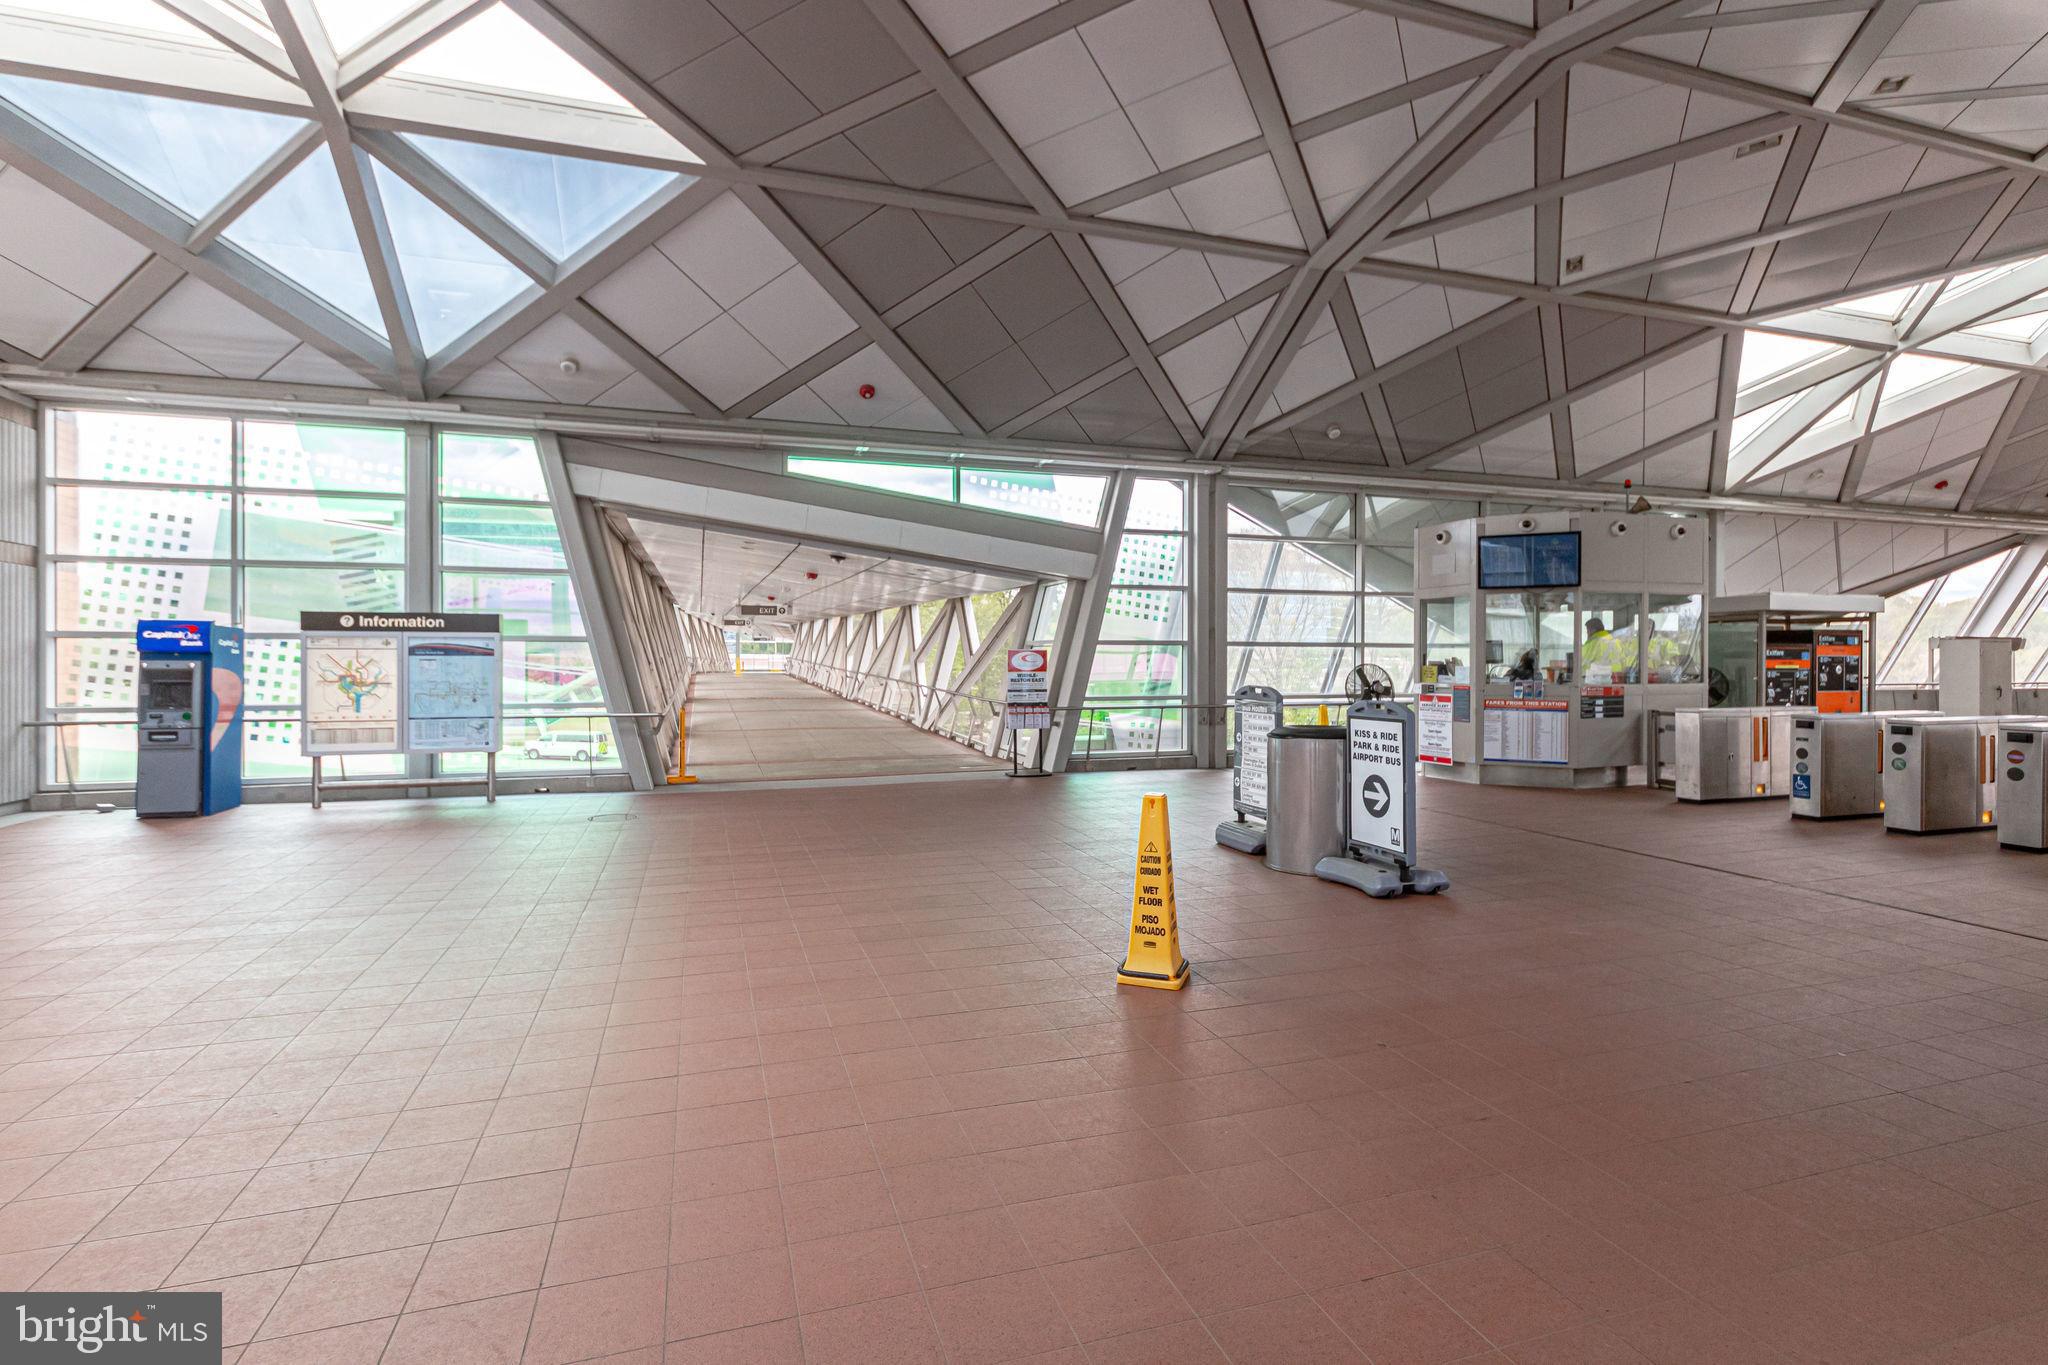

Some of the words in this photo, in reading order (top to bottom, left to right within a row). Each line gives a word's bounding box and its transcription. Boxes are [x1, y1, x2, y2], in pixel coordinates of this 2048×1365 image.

[359, 615, 444, 629] Information
[1354, 729, 1371, 739] KISS
[1372, 731, 1378, 739] &
[1380, 732, 1398, 741] RIDE
[1353, 741, 1372, 751] PARK
[1374, 743, 1380, 751] &
[1382, 744, 1400, 754] RIDE
[1352, 752, 1384, 764] AIRPORT
[1385, 756, 1402, 767] BUS
[1140, 855, 1161, 864] CAUTION
[1140, 867, 1161, 876] CUIDADO
[1142, 886, 1159, 895] WET
[1138, 896, 1163, 907] FLOOR
[1141, 915, 1159, 925] PISO
[1134, 925, 1166, 937] MOJADO
